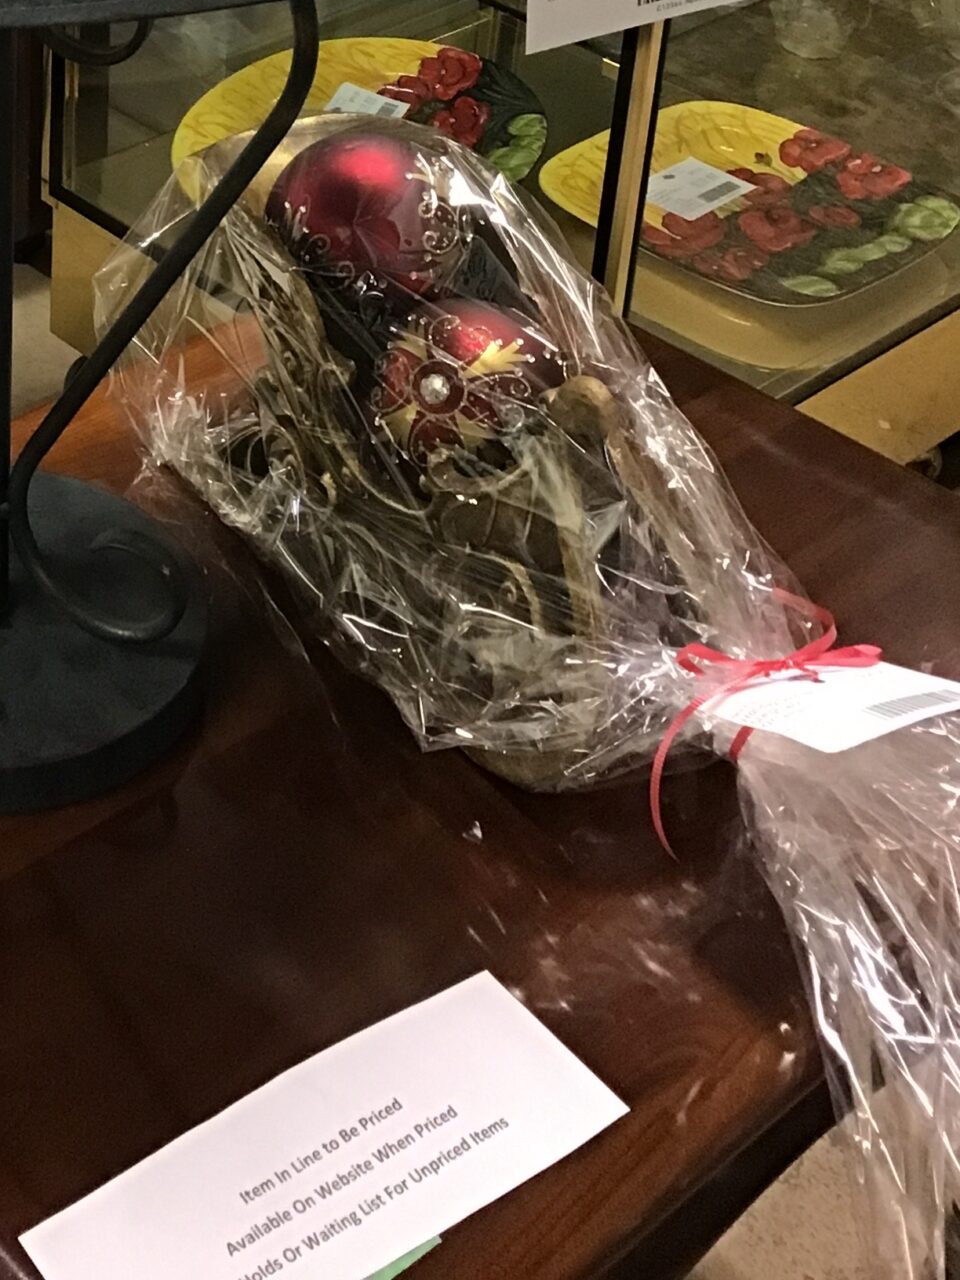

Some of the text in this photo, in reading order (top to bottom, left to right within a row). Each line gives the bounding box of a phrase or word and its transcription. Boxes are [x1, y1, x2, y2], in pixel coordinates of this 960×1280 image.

[226, 1104, 458, 1257] Available On Website When Priced
[239, 1097, 403, 1205] Item In Line to Be Priced
[282, 1245, 303, 1263] Or
[301, 1211, 363, 1251] Waiting
[357, 1194, 386, 1216] List
[383, 1179, 409, 1200] For
[408, 1137, 472, 1184] Unpriced
[469, 1117, 510, 1146] Items
